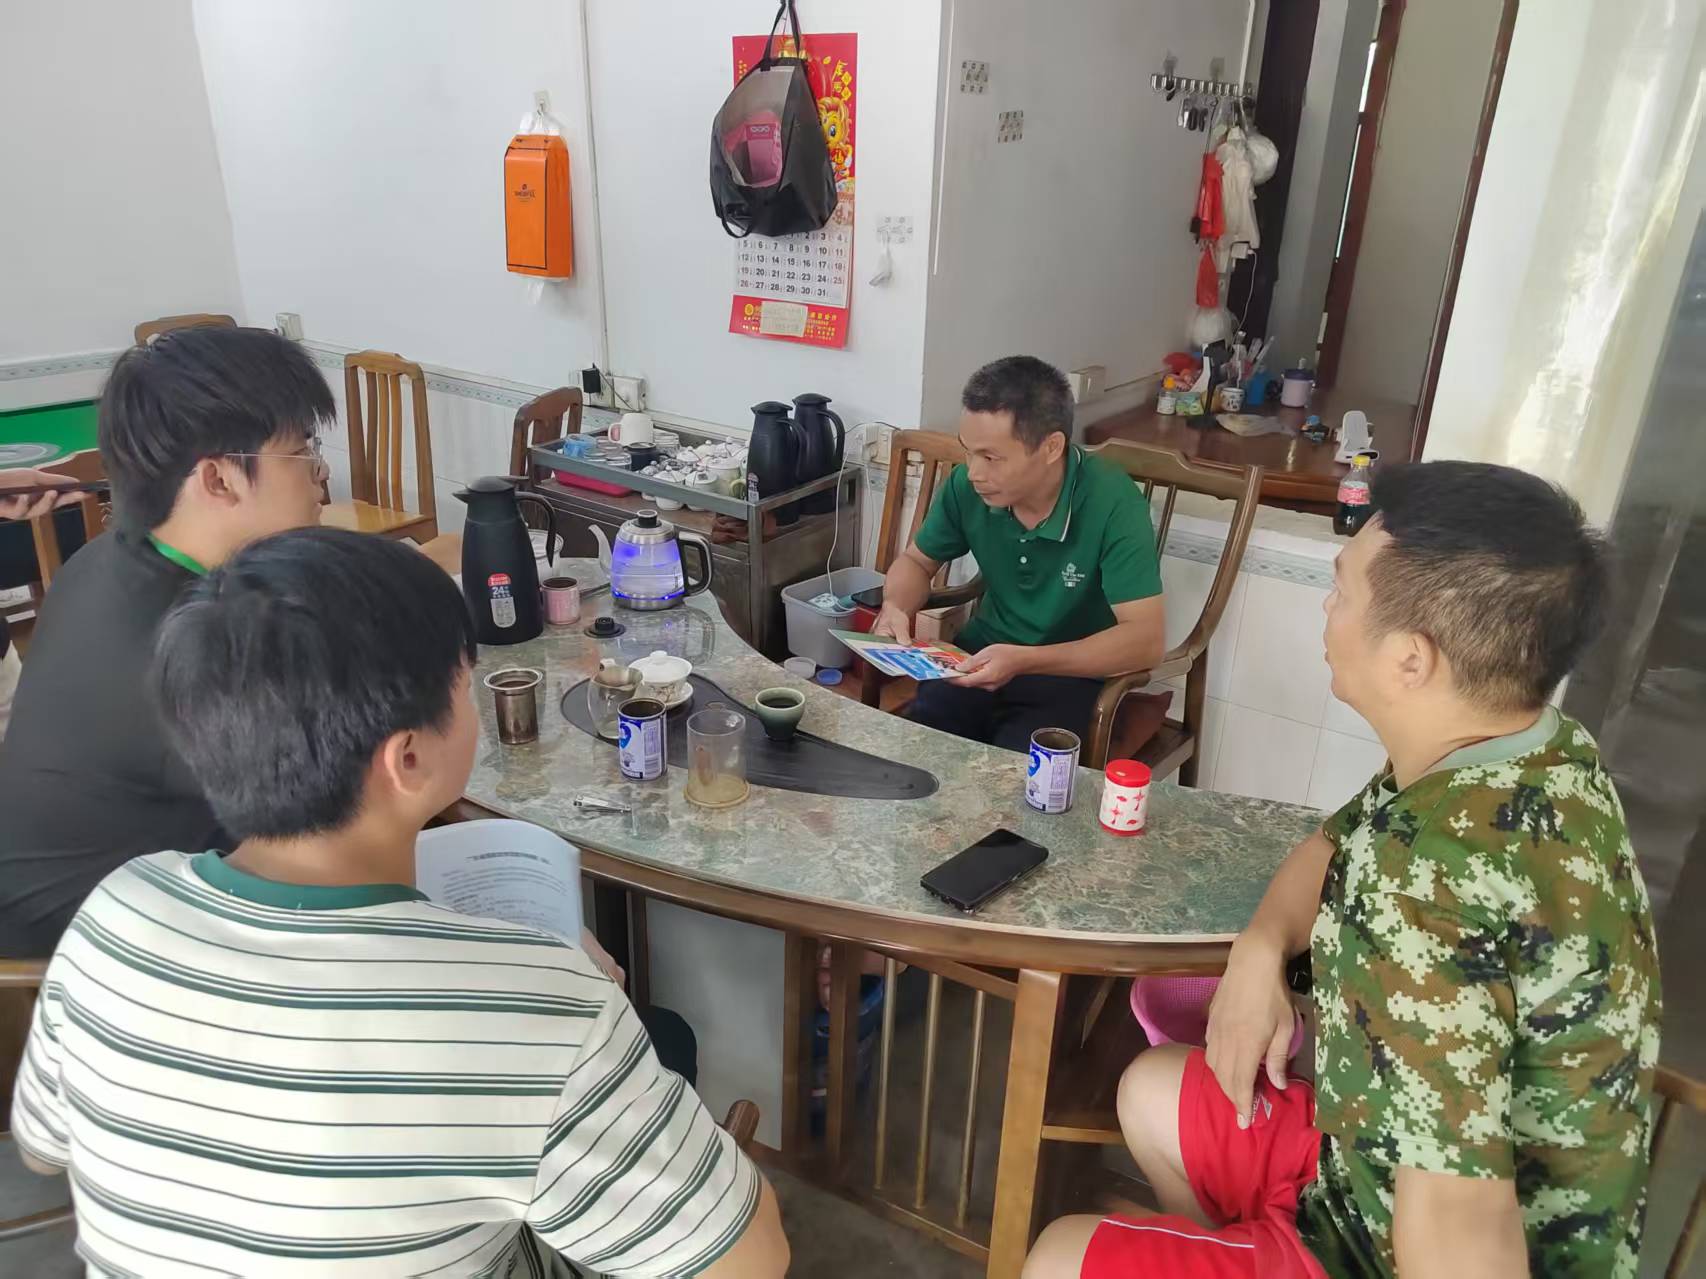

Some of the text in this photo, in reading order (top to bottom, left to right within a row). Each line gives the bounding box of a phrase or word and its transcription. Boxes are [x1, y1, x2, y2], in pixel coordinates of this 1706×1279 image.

[819, 247, 827, 255] 10
[835, 248, 843, 256] 11
[742, 253, 843, 271] 12 13 14 15 16 17 18
[756, 268, 765, 276] 20
[771, 270, 780, 278] 21
[786, 271, 795, 279] 22
[801, 273, 811, 281] 23
[817, 274, 827, 283] 24
[833, 276, 842, 284] 25
[740, 280, 826, 296] 26 27 28 29 30 31
